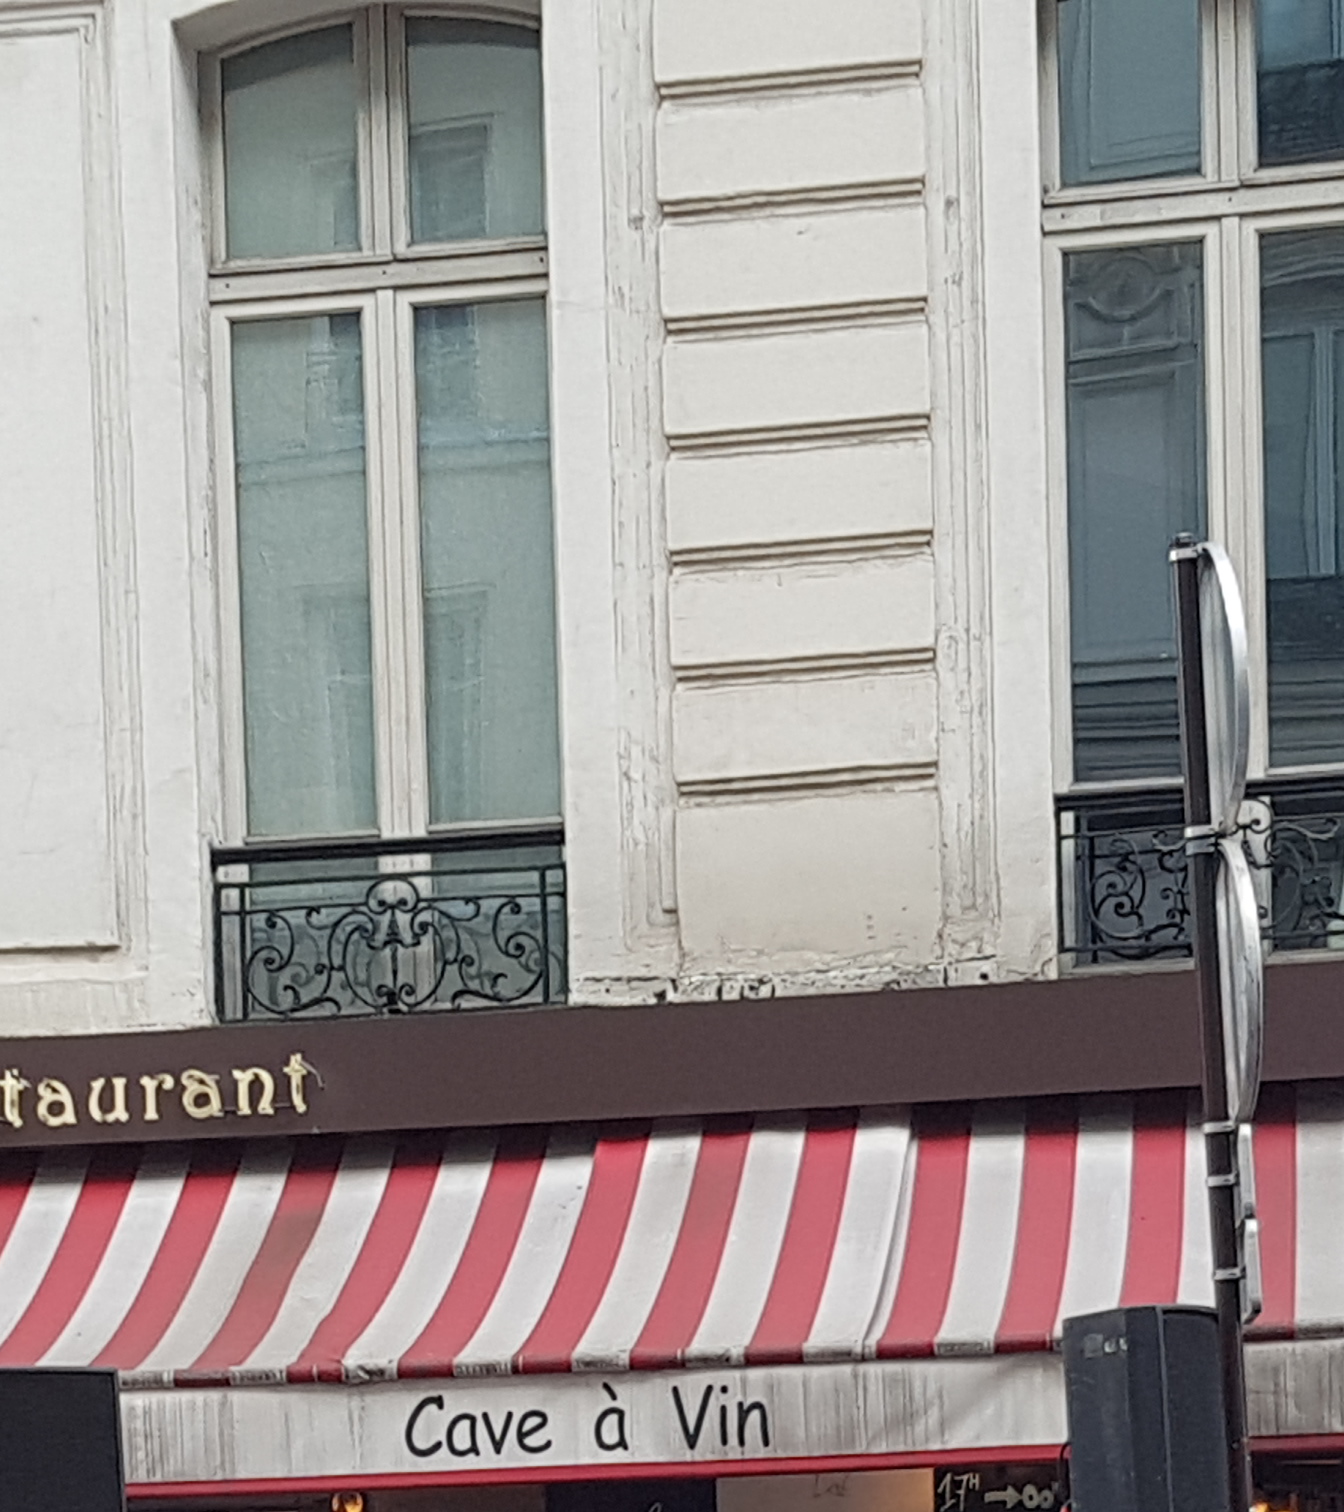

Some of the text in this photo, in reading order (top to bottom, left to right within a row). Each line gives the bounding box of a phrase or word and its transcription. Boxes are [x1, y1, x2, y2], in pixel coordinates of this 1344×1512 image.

[405, 1382, 770, 1457] Cave à Vin
